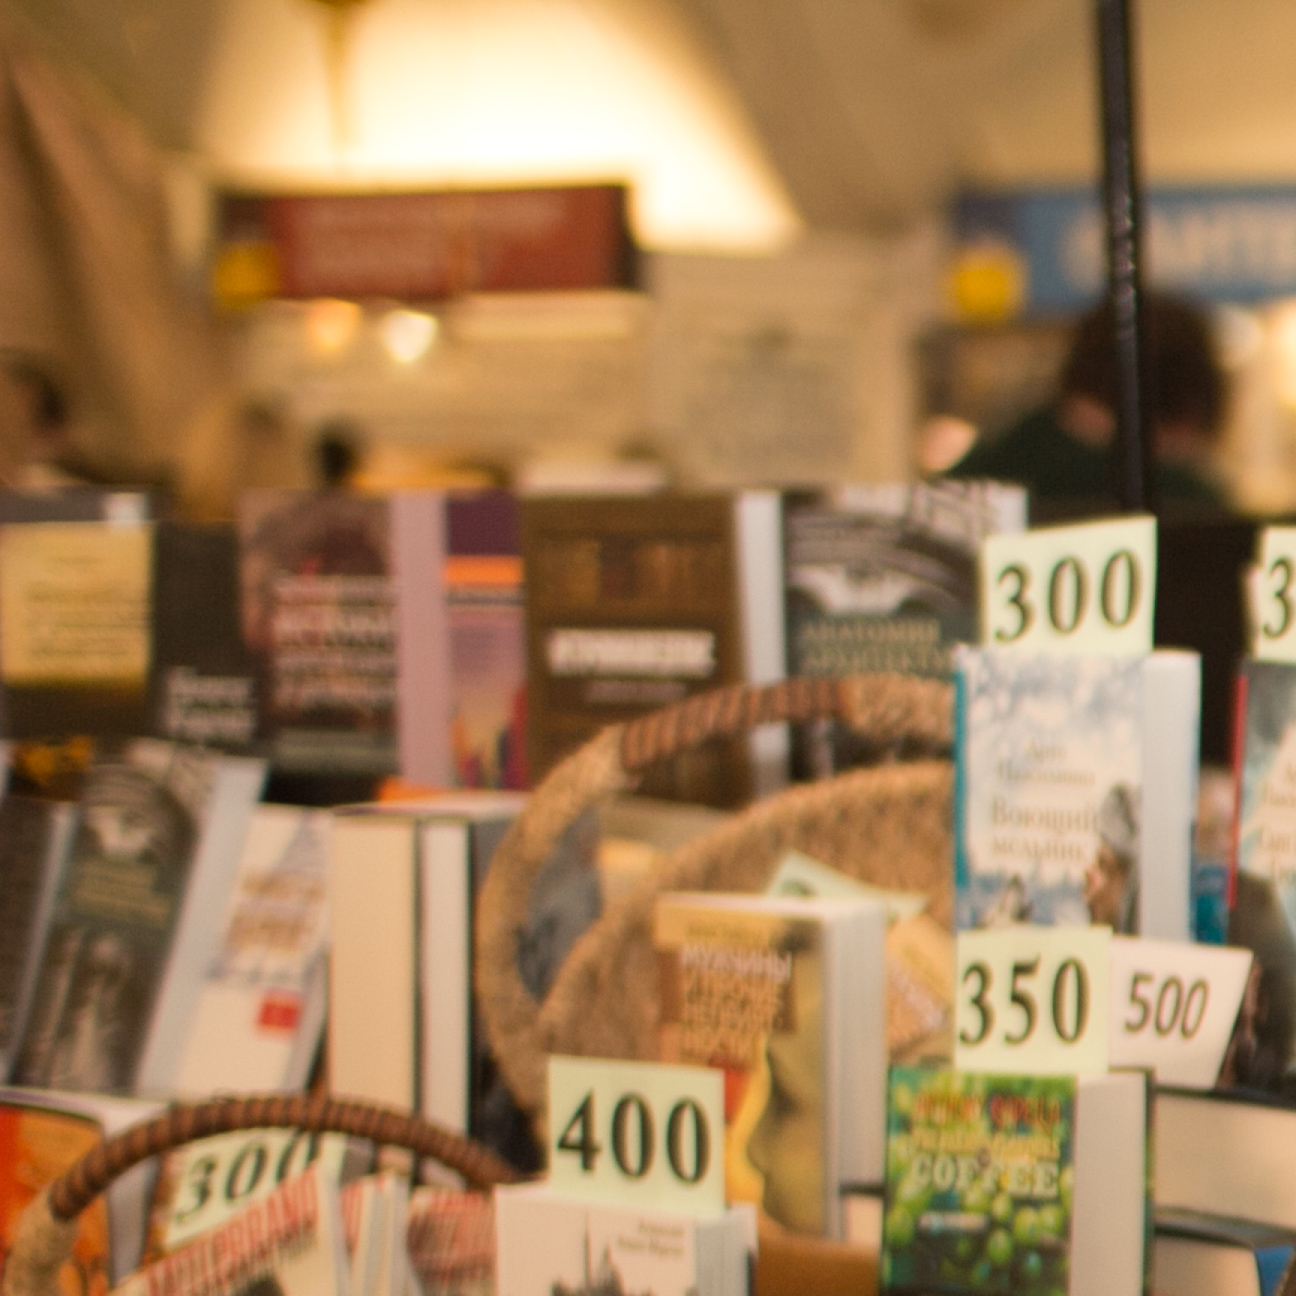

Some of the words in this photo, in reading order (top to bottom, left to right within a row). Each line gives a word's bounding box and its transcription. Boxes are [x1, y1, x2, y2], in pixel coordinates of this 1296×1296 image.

[995, 549, 1142, 642] 300
[957, 956, 1090, 1046] 350
[1124, 971, 1210, 1040] 500
[557, 1089, 712, 1184] 400
[909, 1152, 1060, 1199] COFFEE
